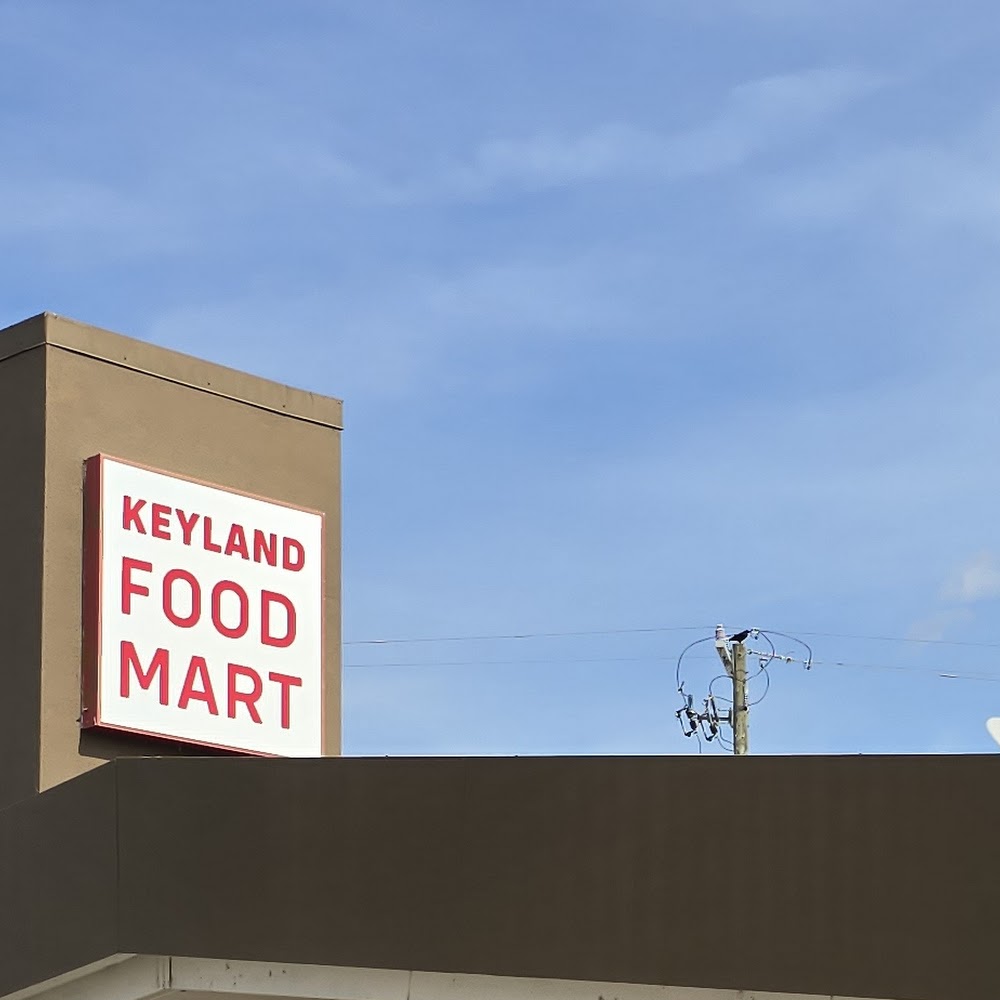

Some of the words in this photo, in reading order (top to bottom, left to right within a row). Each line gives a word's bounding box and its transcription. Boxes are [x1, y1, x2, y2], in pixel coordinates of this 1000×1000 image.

[122, 495, 305, 572] KEYLAND
[121, 556, 296, 648] FOOD
[120, 640, 302, 729] MART
